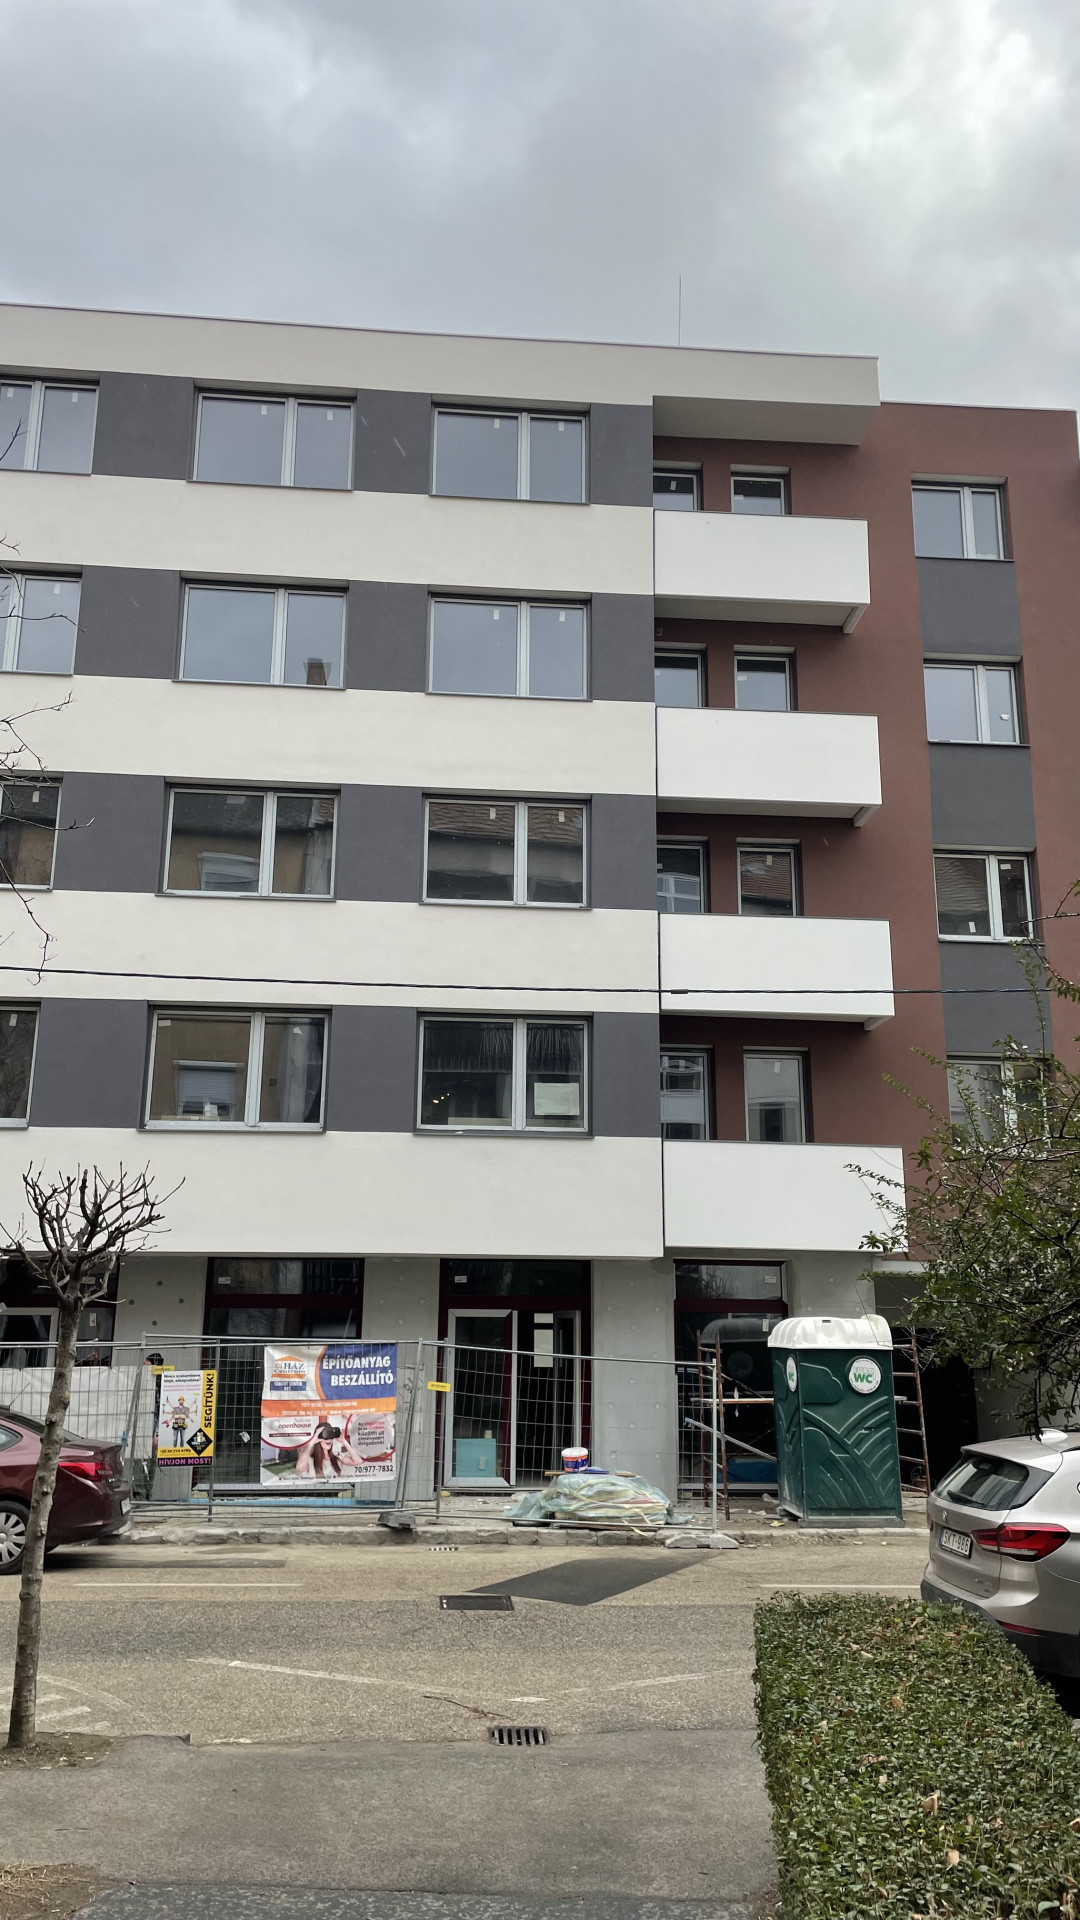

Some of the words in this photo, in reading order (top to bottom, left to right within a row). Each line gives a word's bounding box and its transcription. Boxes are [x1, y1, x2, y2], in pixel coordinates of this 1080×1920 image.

[322, 1355, 391, 1370] ÉPÍTŐANYAG
[331, 1370, 394, 1386] BESZÁLLÍTÓ
[854, 1373, 873, 1384] WC
[204, 1373, 214, 1428] SEGÍTÜNK!
[277, 1422, 312, 1430] openhouse
[158, 1458, 186, 1466] HÍVJON
[187, 1457, 211, 1465] MOST!
[354, 1464, 394, 1474] 70/977-7832
[943, 1530, 970, 1553] SKT-986
